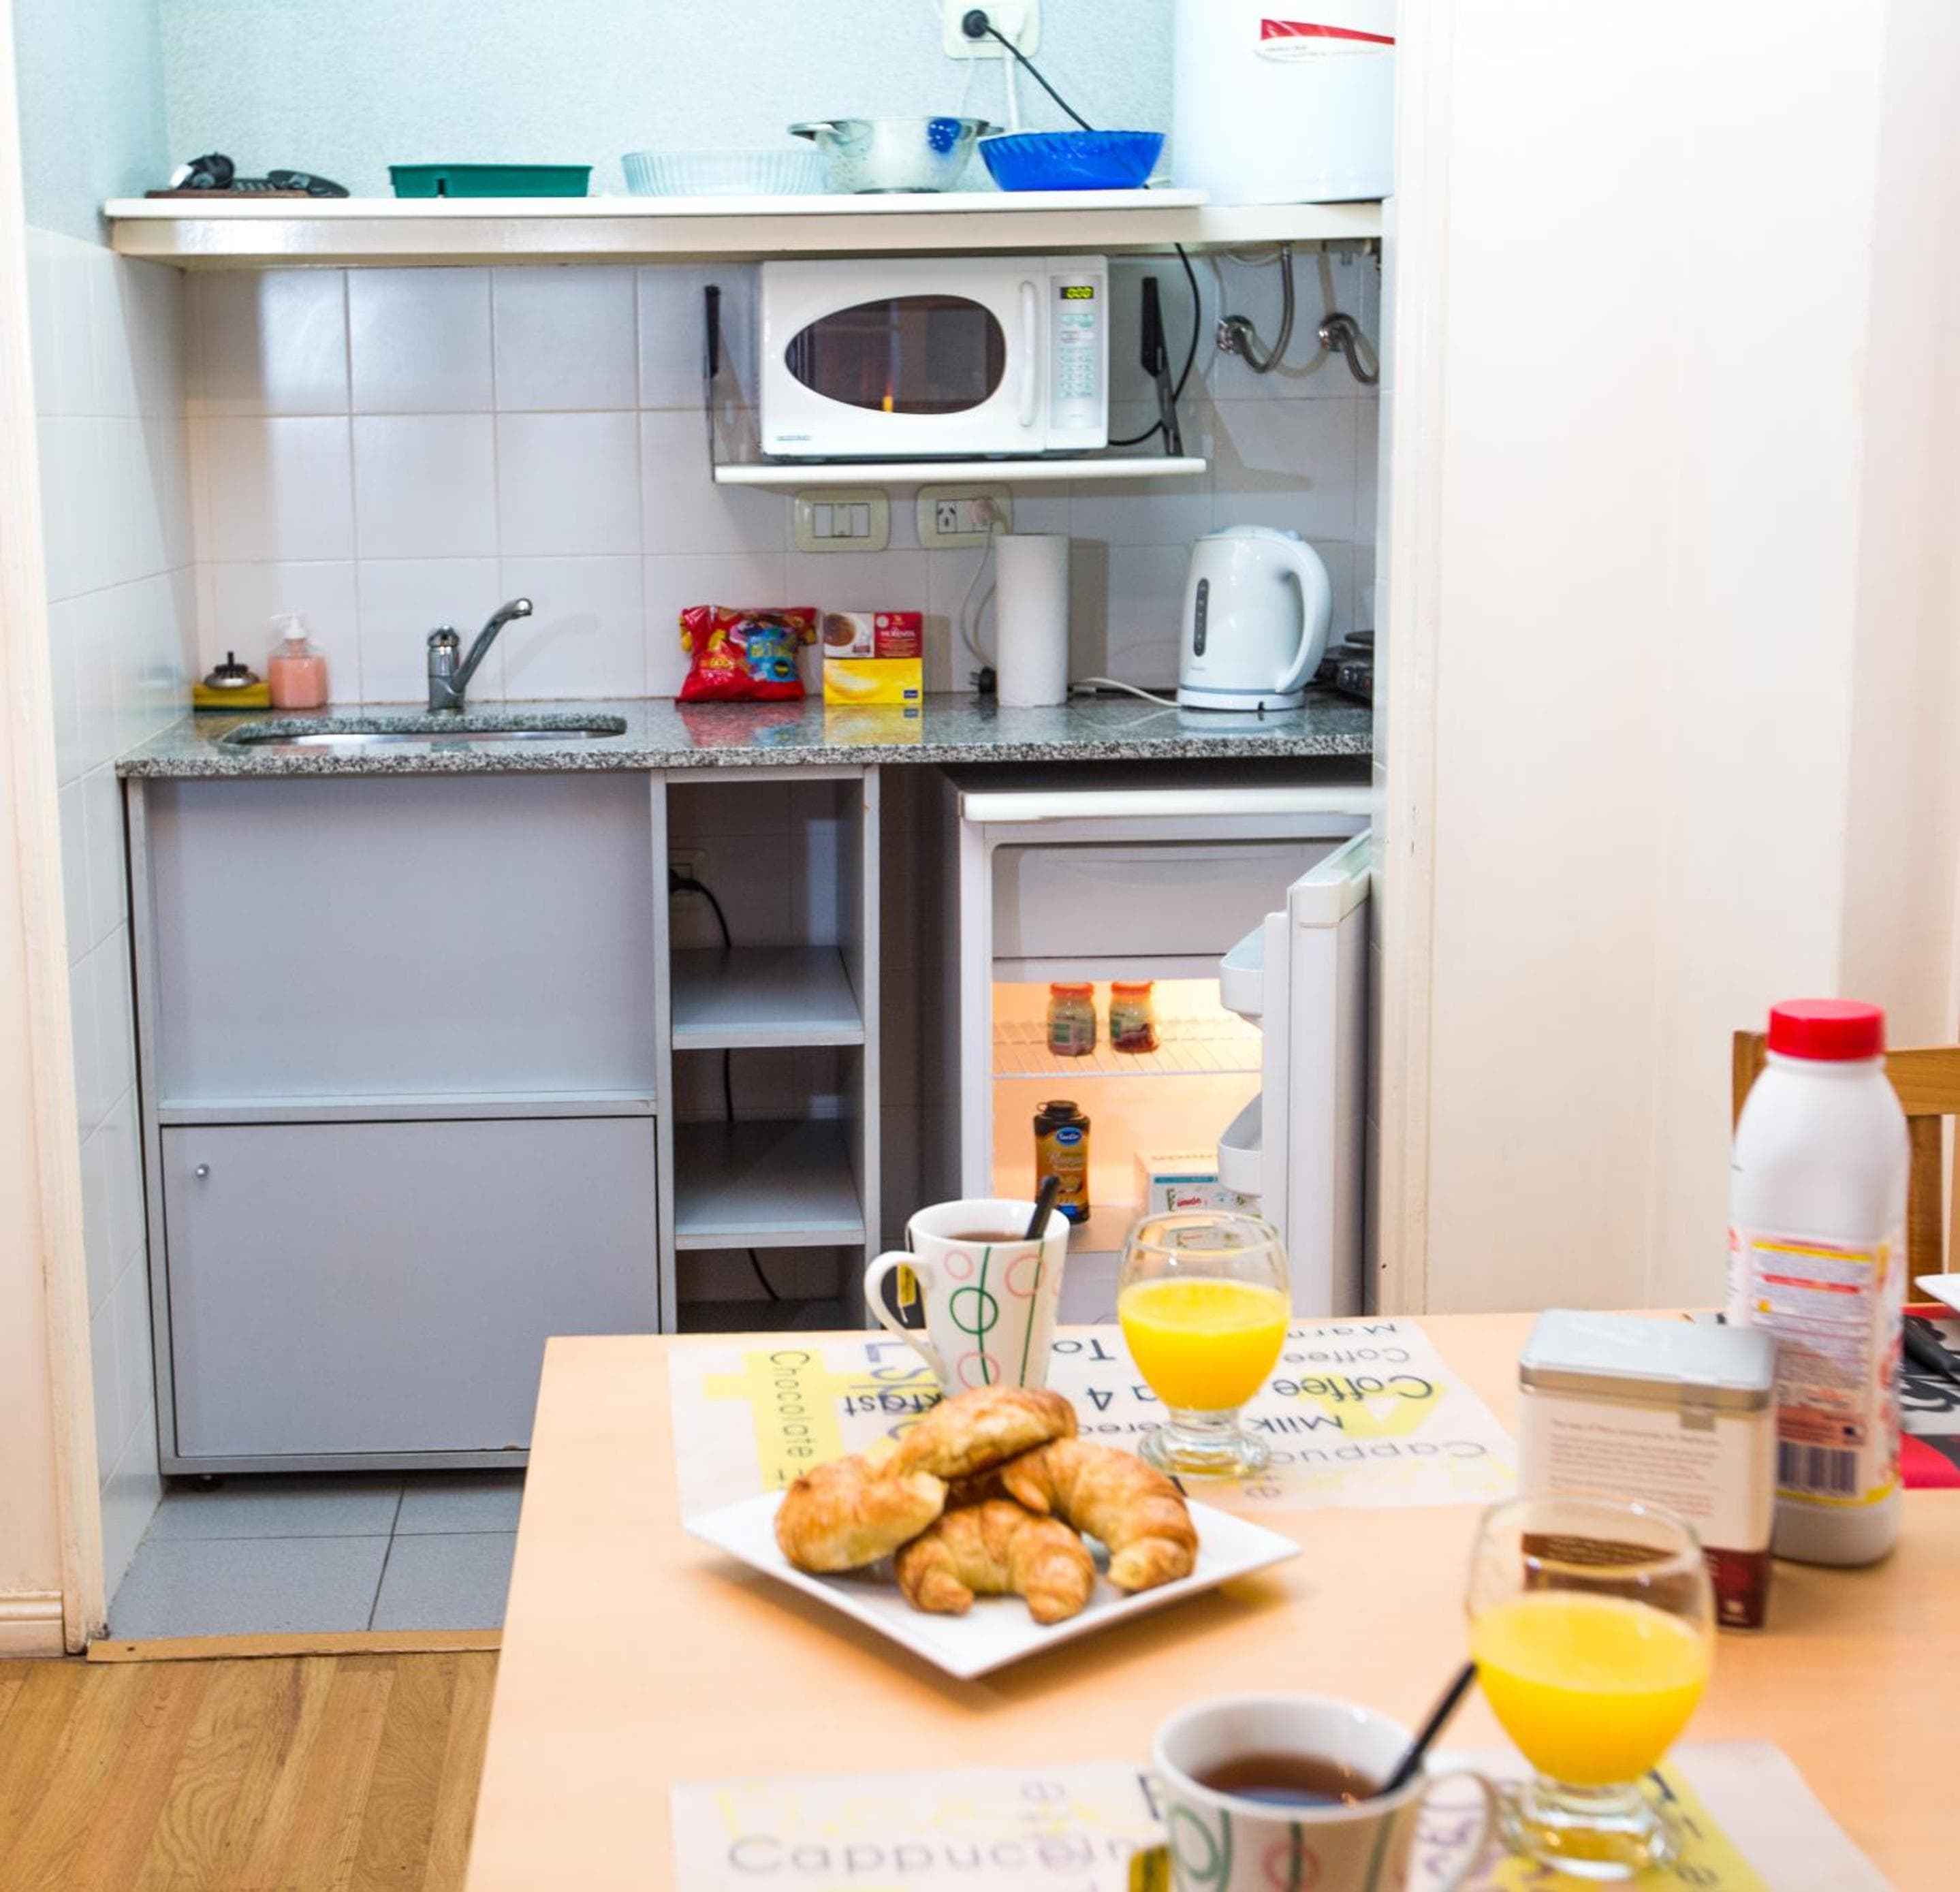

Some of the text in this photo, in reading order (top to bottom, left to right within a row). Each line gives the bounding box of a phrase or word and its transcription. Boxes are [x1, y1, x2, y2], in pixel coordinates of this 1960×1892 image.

[1272, 1374, 1434, 1402] Coffee
[1246, 1413, 1346, 1434] Milk
[1271, 1440, 1487, 1464] Cappuc
